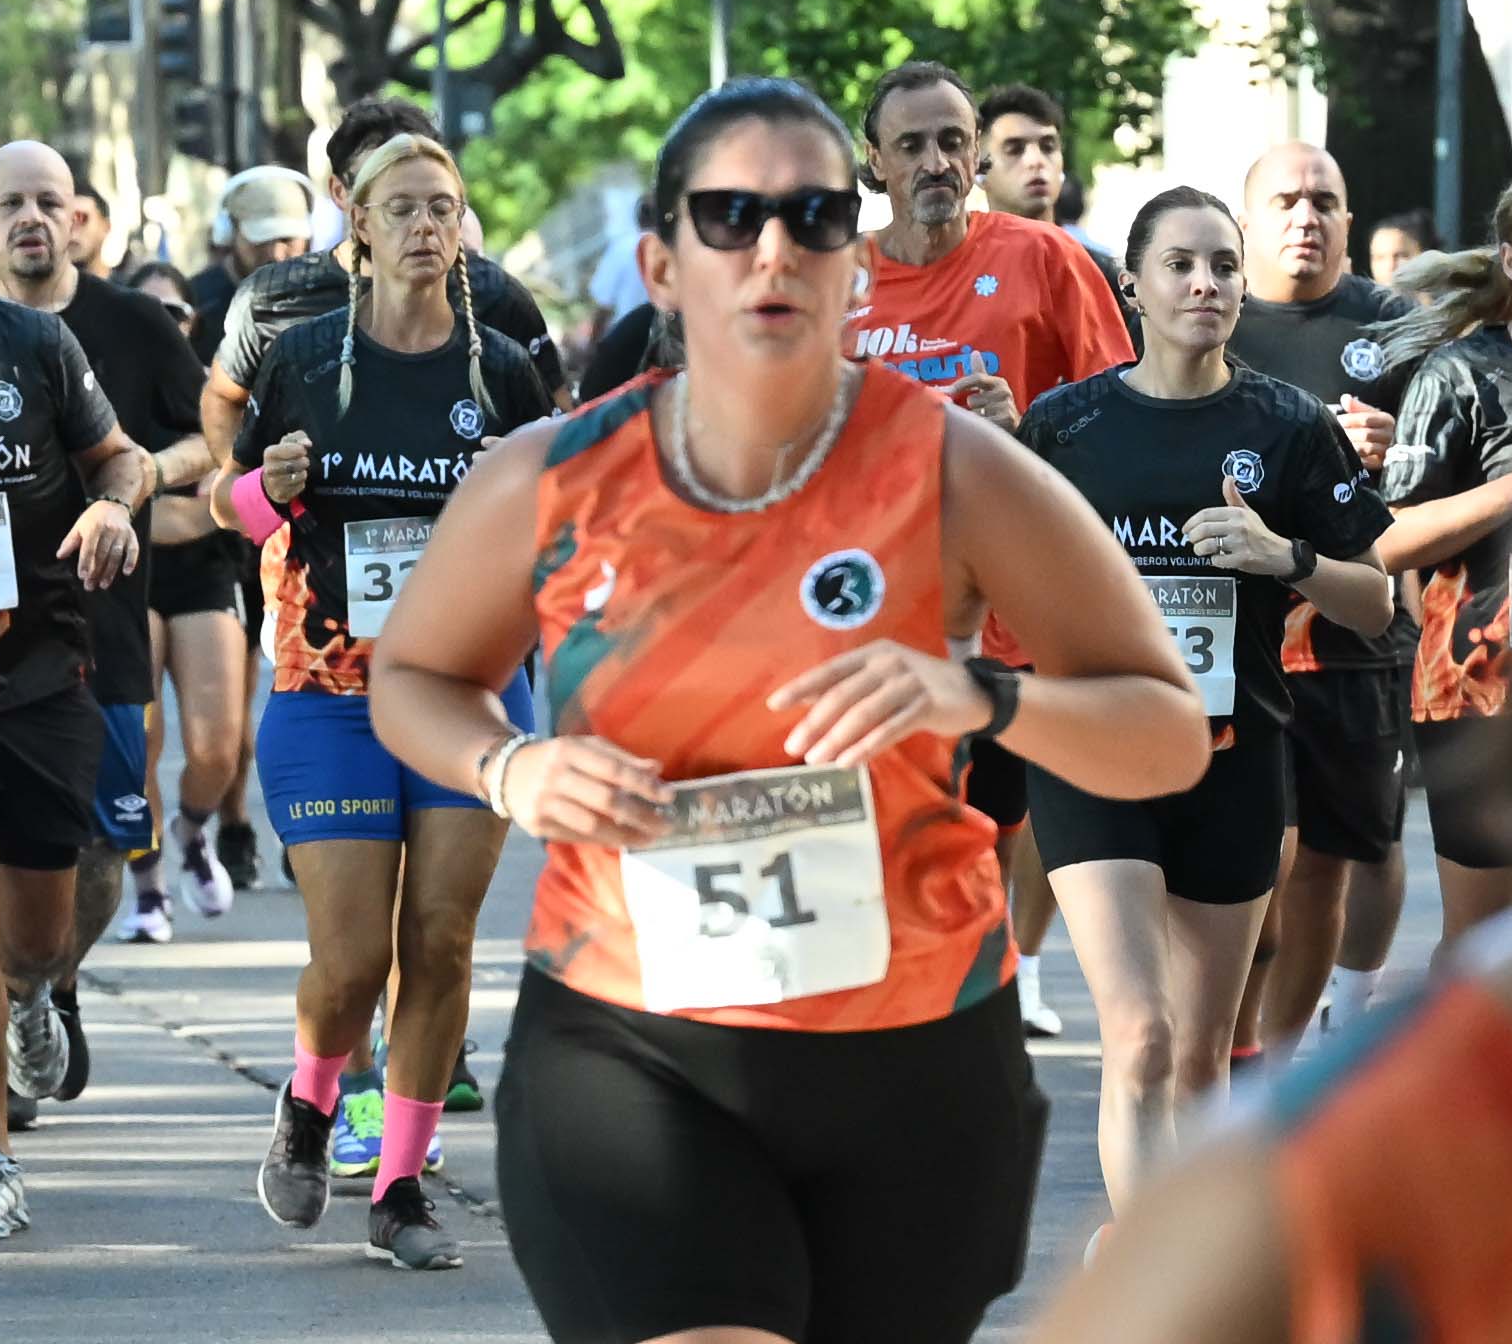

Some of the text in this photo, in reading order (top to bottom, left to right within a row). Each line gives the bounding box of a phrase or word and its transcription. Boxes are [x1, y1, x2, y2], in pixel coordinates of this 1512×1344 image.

[352, 451, 469, 485] MARATÓ
[289, 801, 303, 820] LE
[304, 799, 336, 817] COQ
[693, 852, 818, 938] 51
